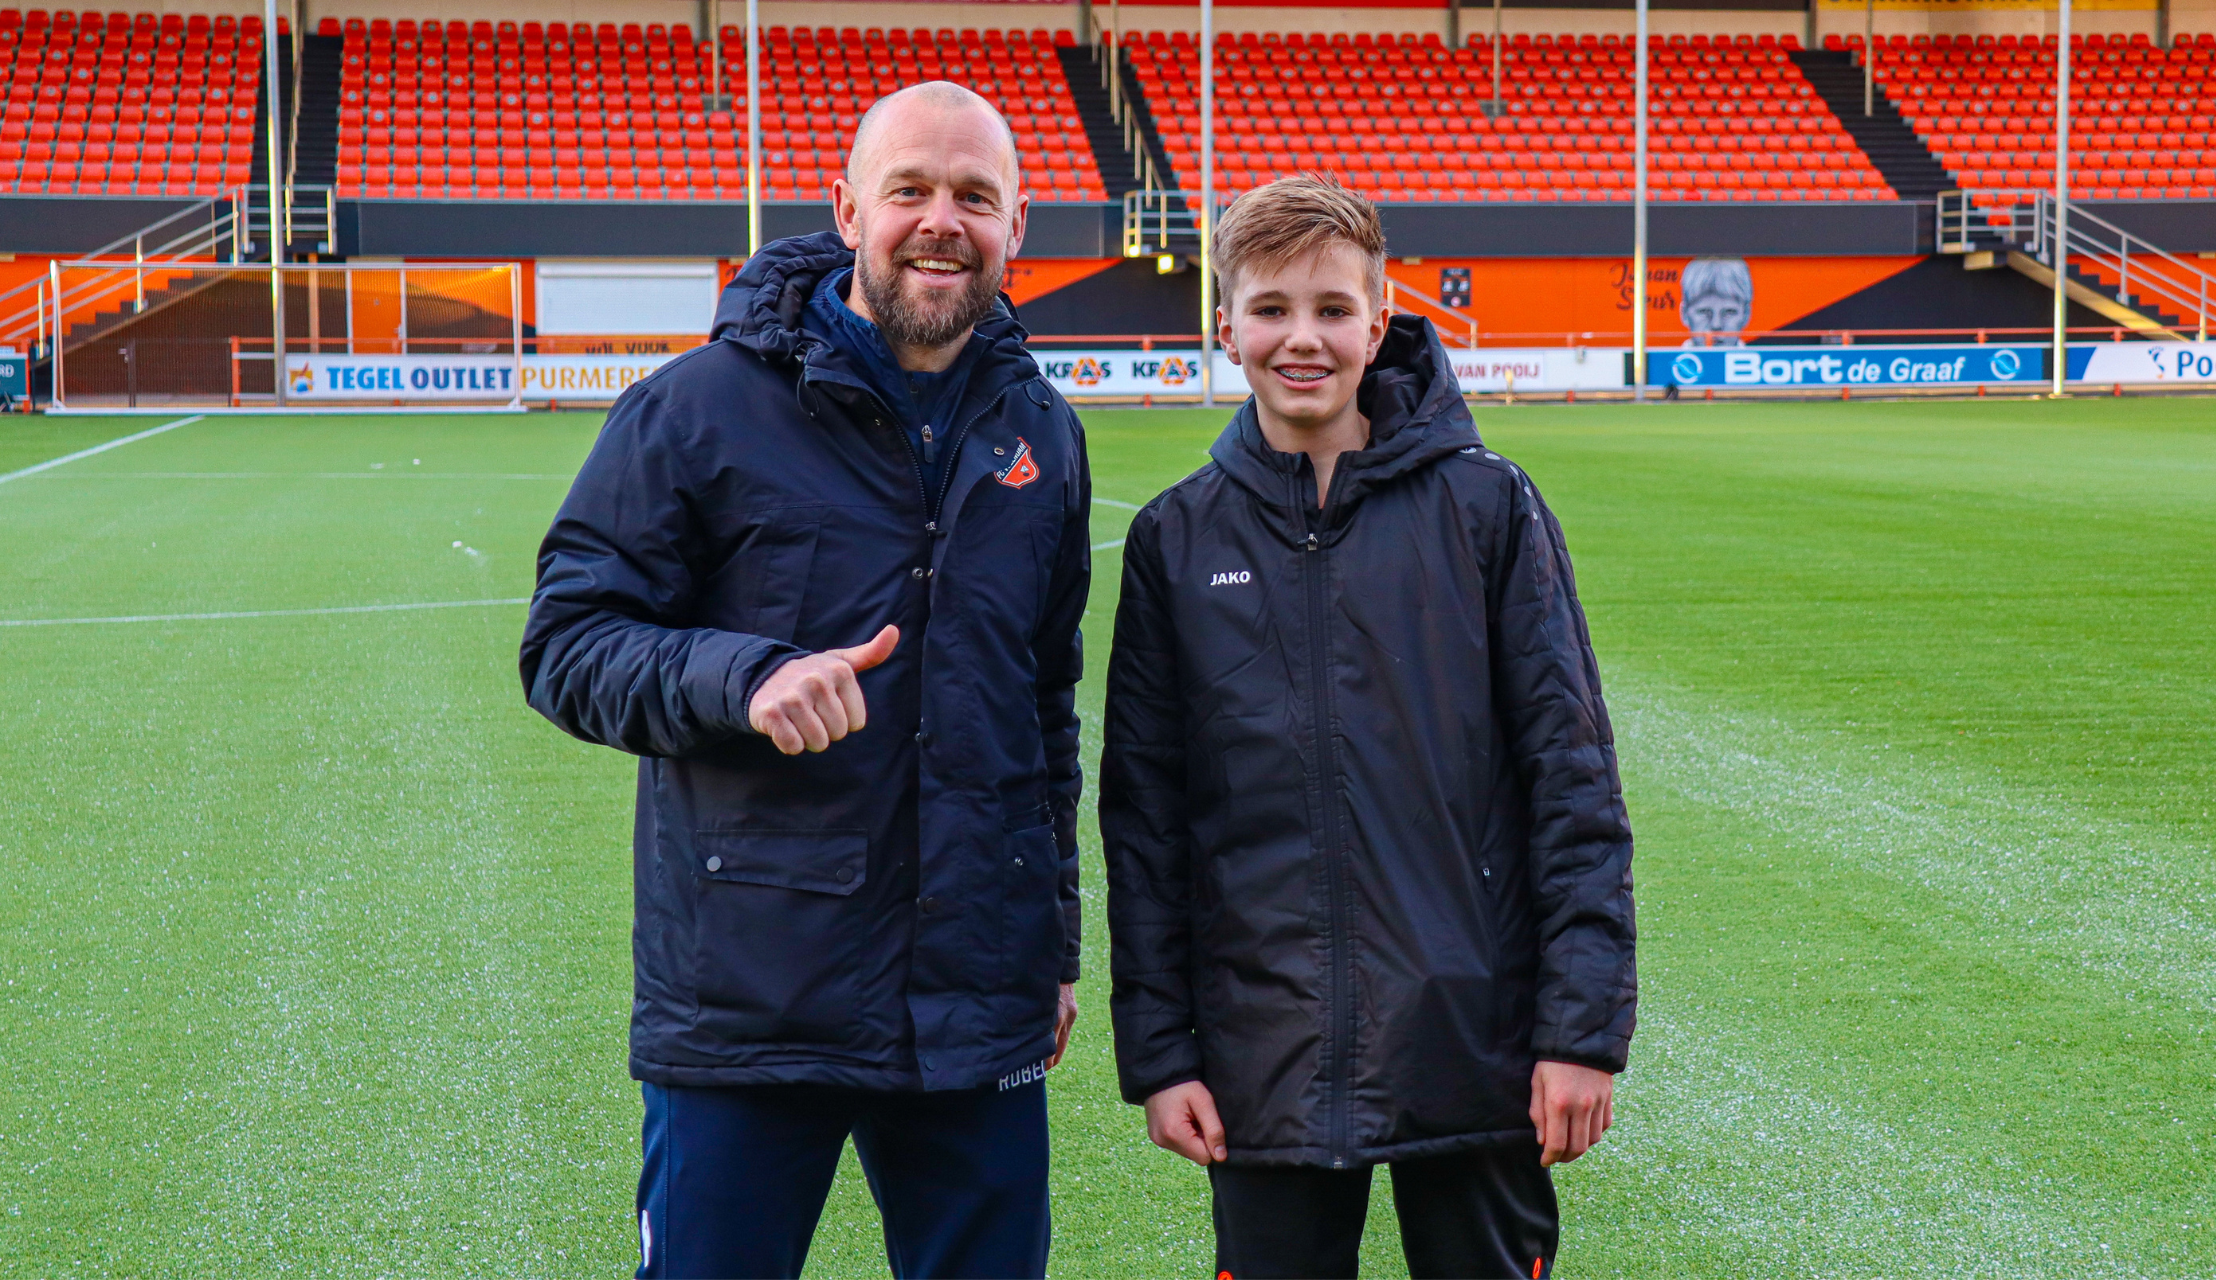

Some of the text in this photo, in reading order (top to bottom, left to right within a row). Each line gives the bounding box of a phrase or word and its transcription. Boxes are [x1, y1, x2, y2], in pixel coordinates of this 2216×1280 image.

[1454, 364, 1485, 377] VAN
[1724, 352, 1966, 383] Bort de Graaf
[327, 366, 659, 390] TEGEL OUTLET PURMERE
[1210, 571, 1251, 586] JAKO
